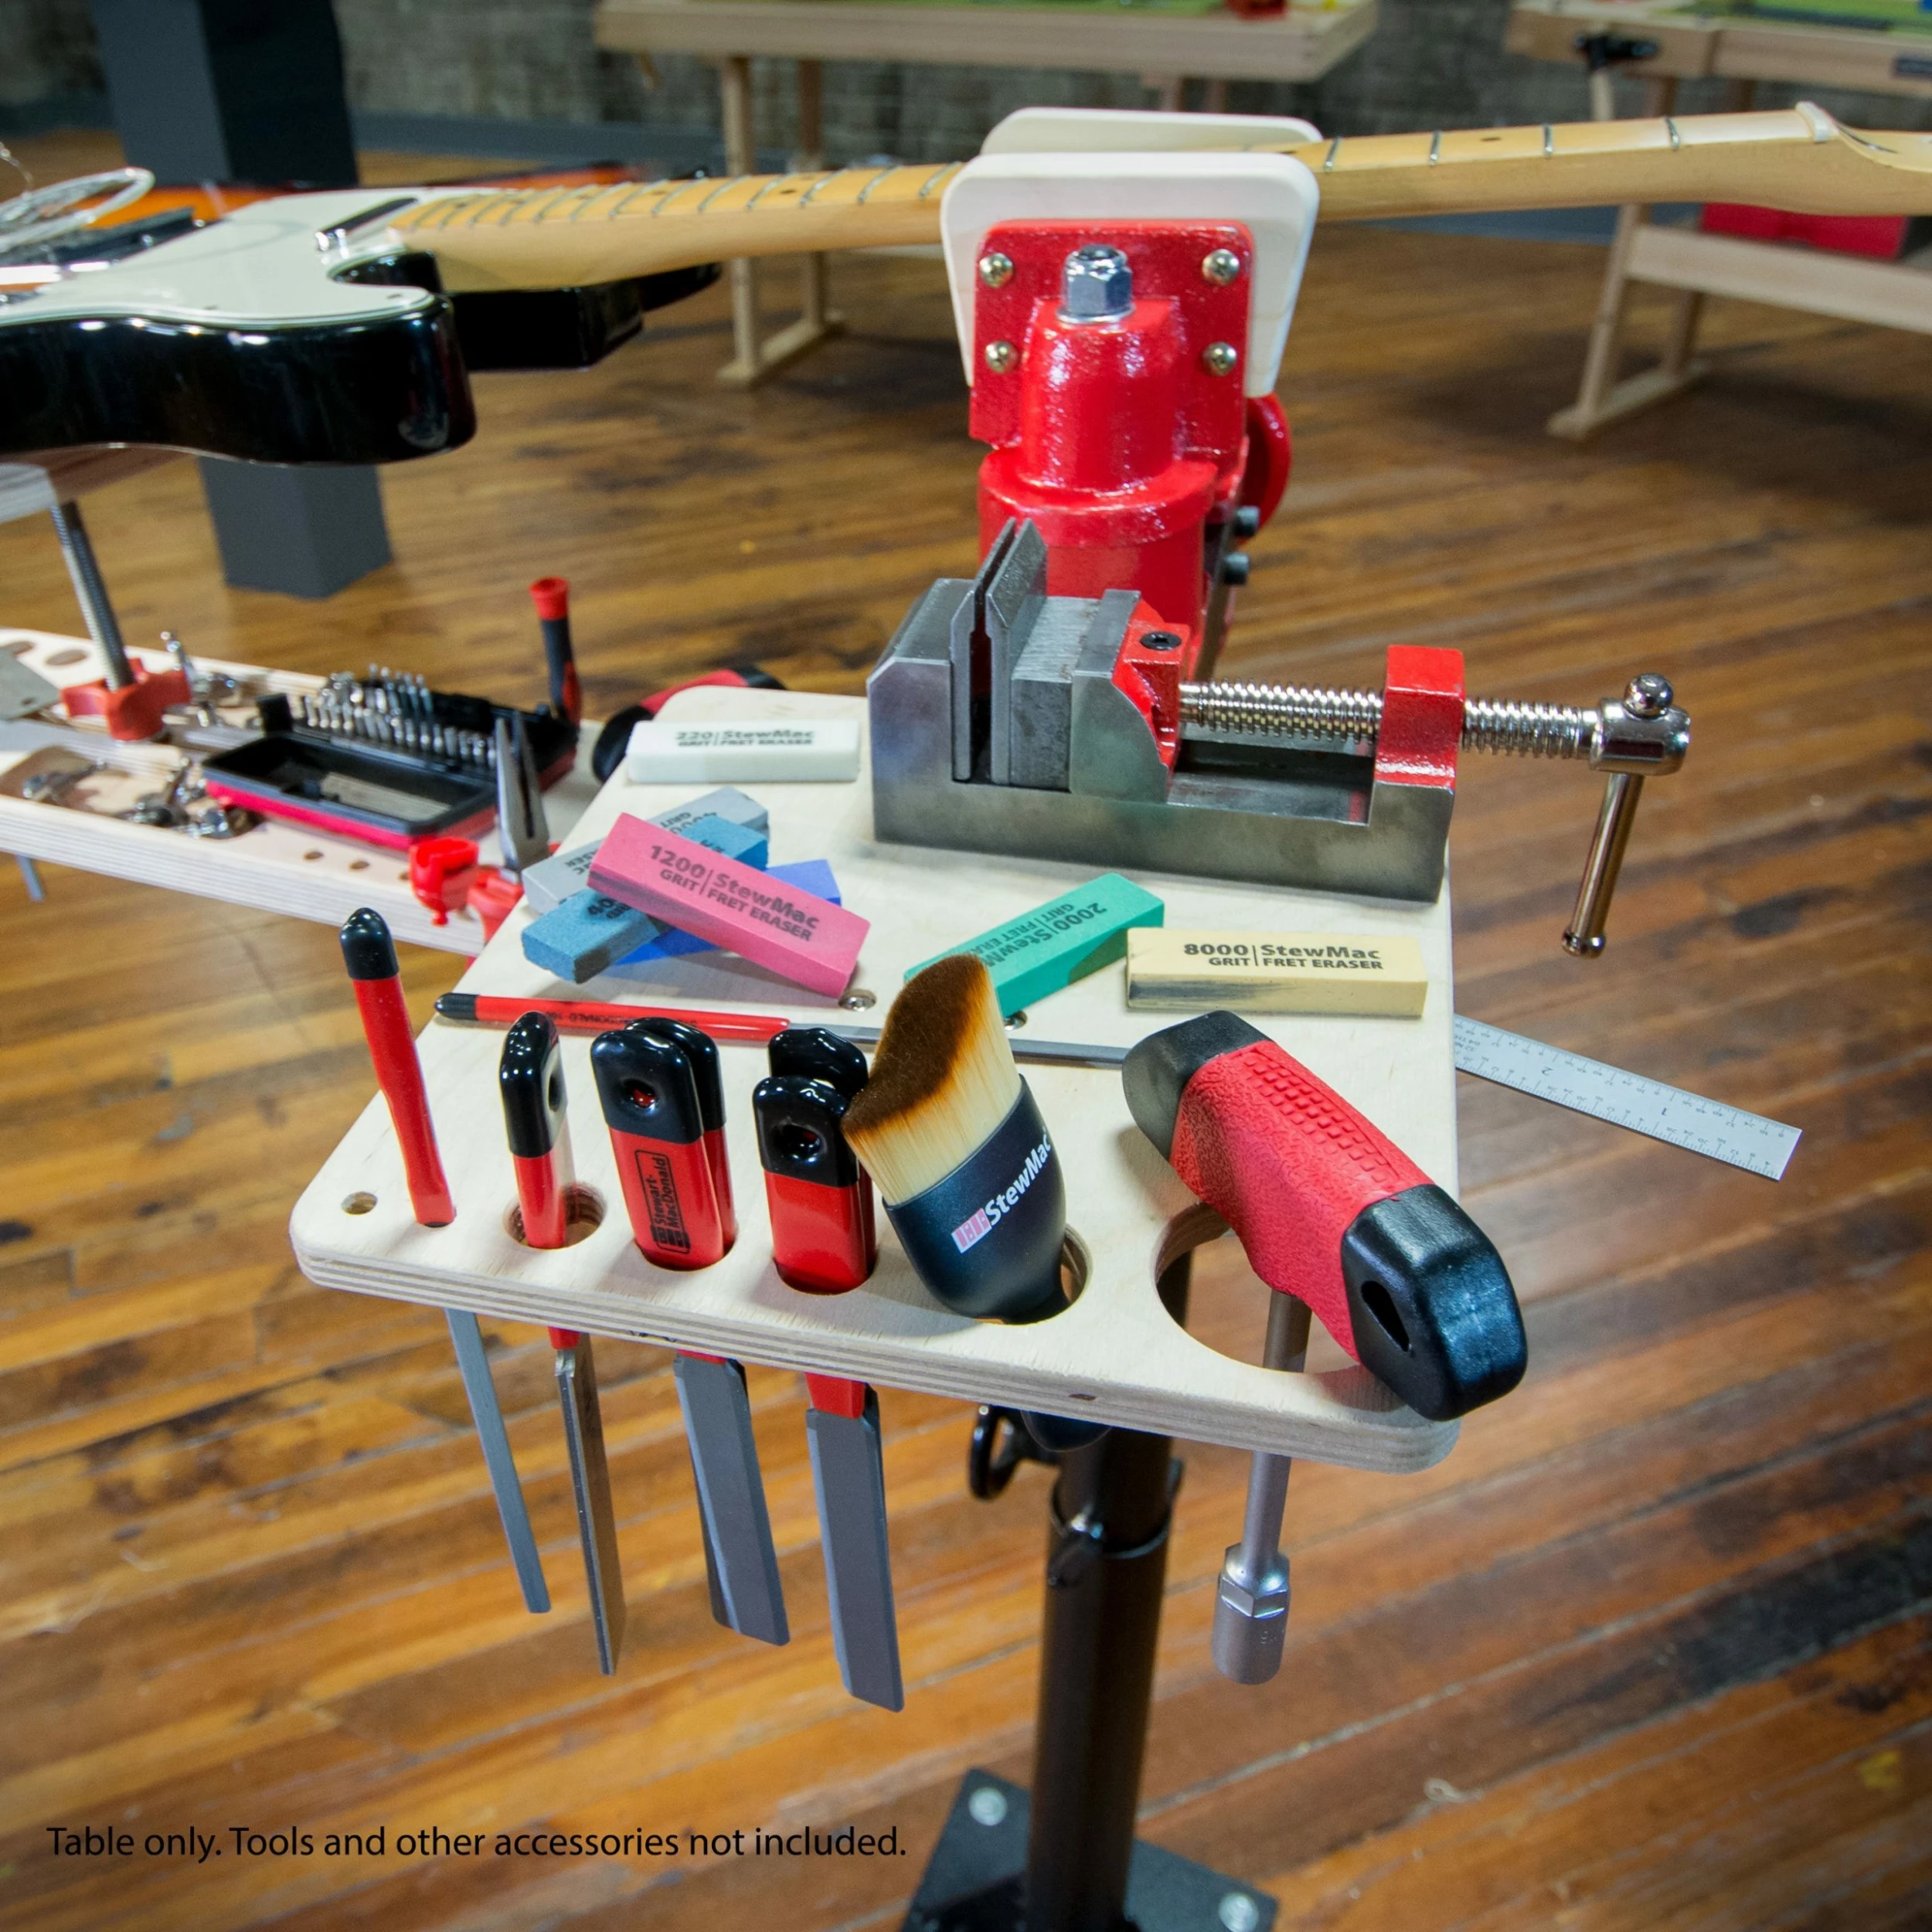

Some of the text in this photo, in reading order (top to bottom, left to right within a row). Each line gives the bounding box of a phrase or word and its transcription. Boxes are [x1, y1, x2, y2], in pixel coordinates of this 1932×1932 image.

[722, 730, 815, 739] StewMac
[651, 845, 819, 928] 1200 StewMac
[659, 869, 813, 941] GRIT FRET ERASER
[981, 903, 1107, 967] 2000 StewM
[1002, 920, 1039, 941] FRET
[1041, 903, 1074, 922] GRIT
[1184, 944, 1381, 959] 8000 StewMac
[1209, 957, 1383, 969] GRIT FRET ERASER
[1541, 1066, 1668, 1116] 1 2
[646, 1175, 665, 1225] Stewart-
[653, 1157, 679, 1228] MacDonald
[985, 1133, 1052, 1226] StewMac
